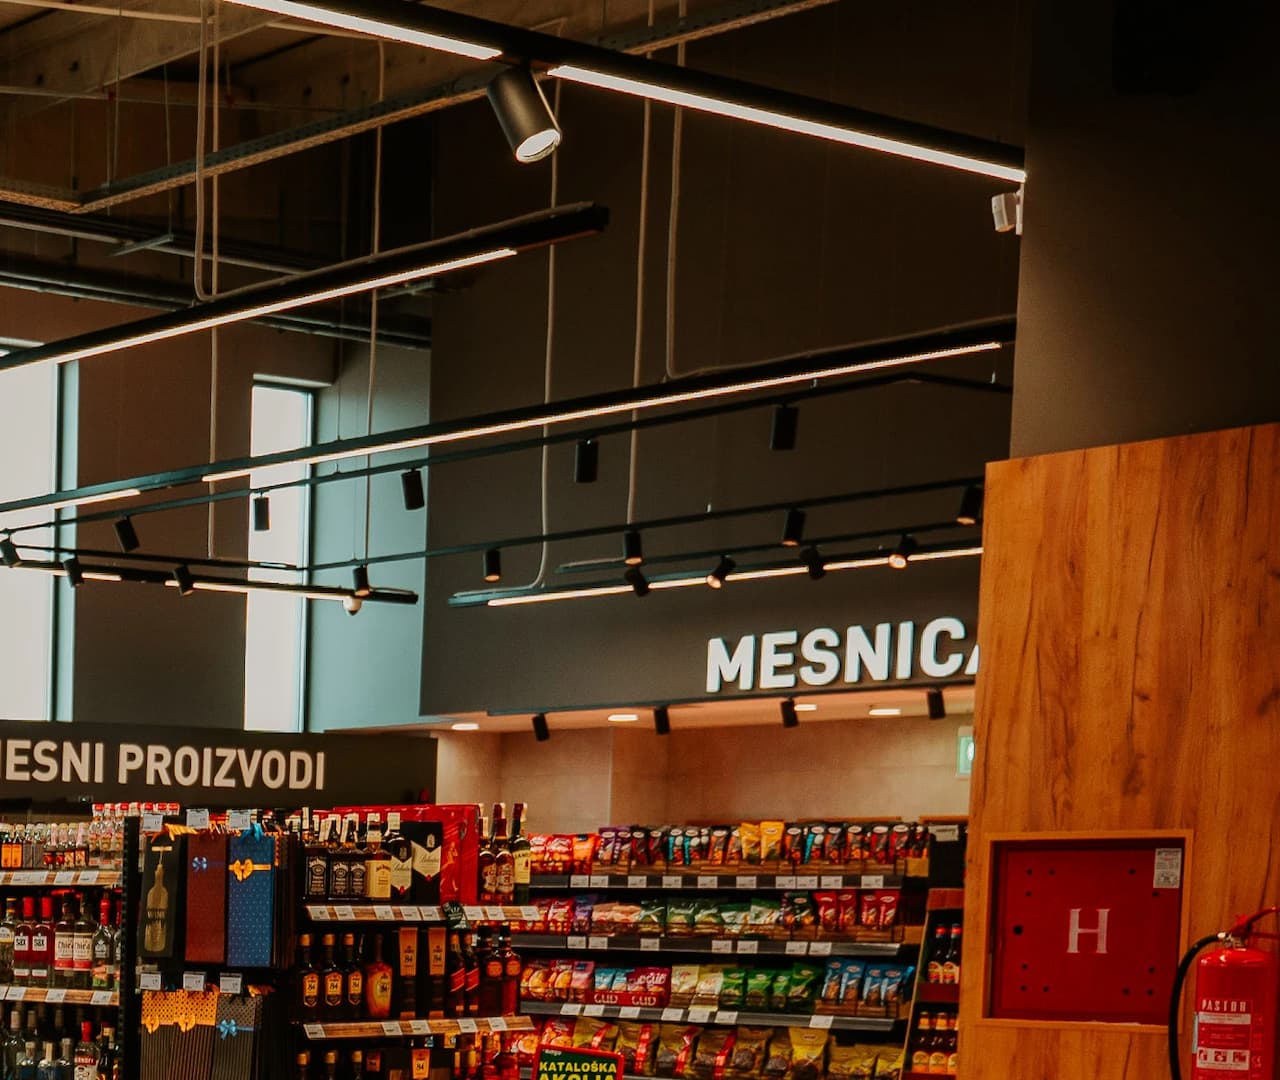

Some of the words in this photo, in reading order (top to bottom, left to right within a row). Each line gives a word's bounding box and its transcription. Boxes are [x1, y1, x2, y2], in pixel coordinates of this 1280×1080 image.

[118, 743, 325, 791] PROIZVODI
[1067, 908, 1110, 954] H
[539, 1061, 616, 1073] KATALOŠKA
